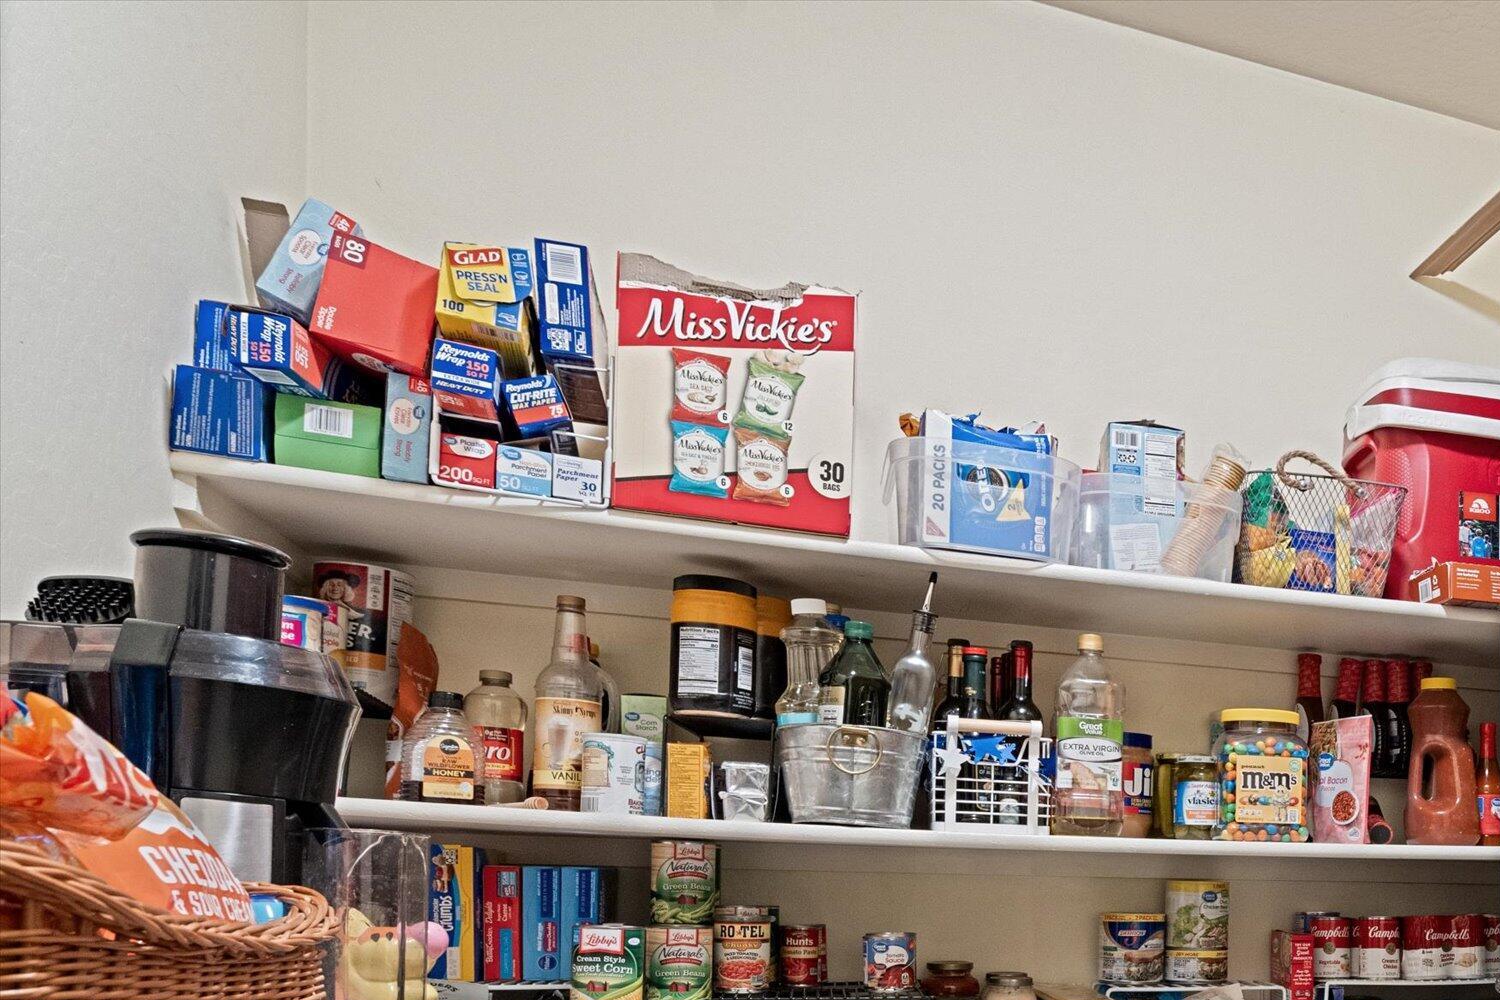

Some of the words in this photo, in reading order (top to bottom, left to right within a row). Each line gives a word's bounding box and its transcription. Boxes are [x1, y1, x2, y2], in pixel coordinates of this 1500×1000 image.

[343, 240, 365, 263] 80
[454, 251, 500, 265] GLAD
[456, 270, 508, 284] PRESS'N
[468, 281, 500, 293] SEAL
[442, 299, 464, 312] 100
[260, 316, 274, 343] Wrap
[275, 320, 288, 364] Reynolds
[259, 342, 272, 363] 150
[439, 342, 490, 362] Reynolds
[435, 351, 466, 367] Wrap
[466, 360, 490, 373] 150
[506, 379, 543, 393] Reynolds
[510, 388, 557, 404] CUT-RITE
[532, 397, 556, 408] PAPER
[550, 405, 564, 417] 75
[722, 412, 728, 421] 6
[784, 422, 793, 431] 12
[464, 446, 486, 455] Wrap
[440, 465, 473, 481] 200
[511, 463, 548, 474] Parchment
[557, 468, 599, 480] Parchment
[819, 460, 845, 484] 30
[932, 444, 946, 493] PACKS
[500, 476, 520, 488] 50
[556, 474, 578, 482] Paper
[721, 477, 727, 486] 6
[581, 482, 597, 492] 30
[784, 486, 790, 495] 6
[822, 483, 841, 492] BAGS
[932, 493, 945, 511] 20
[1079, 721, 1103, 731] Great
[1063, 743, 1090, 751] EXTRA
[1093, 744, 1121, 753] VIRGIN
[432, 769, 465, 777] HONEY
[1187, 797, 1215, 805] vlasic
[666, 861, 709, 873] Naturals
[662, 882, 688, 891] Green
[690, 883, 711, 891] Beans
[586, 933, 617, 947] Libby's
[1424, 928, 1470, 941] Campbell's
[658, 947, 703, 959] Naturals
[576, 955, 601, 963] Cream
[603, 955, 626, 964] Style
[572, 963, 601, 973] Sweet
[603, 963, 633, 975] Corn
[655, 969, 680, 977] Green
[683, 970, 706, 978] Beans
